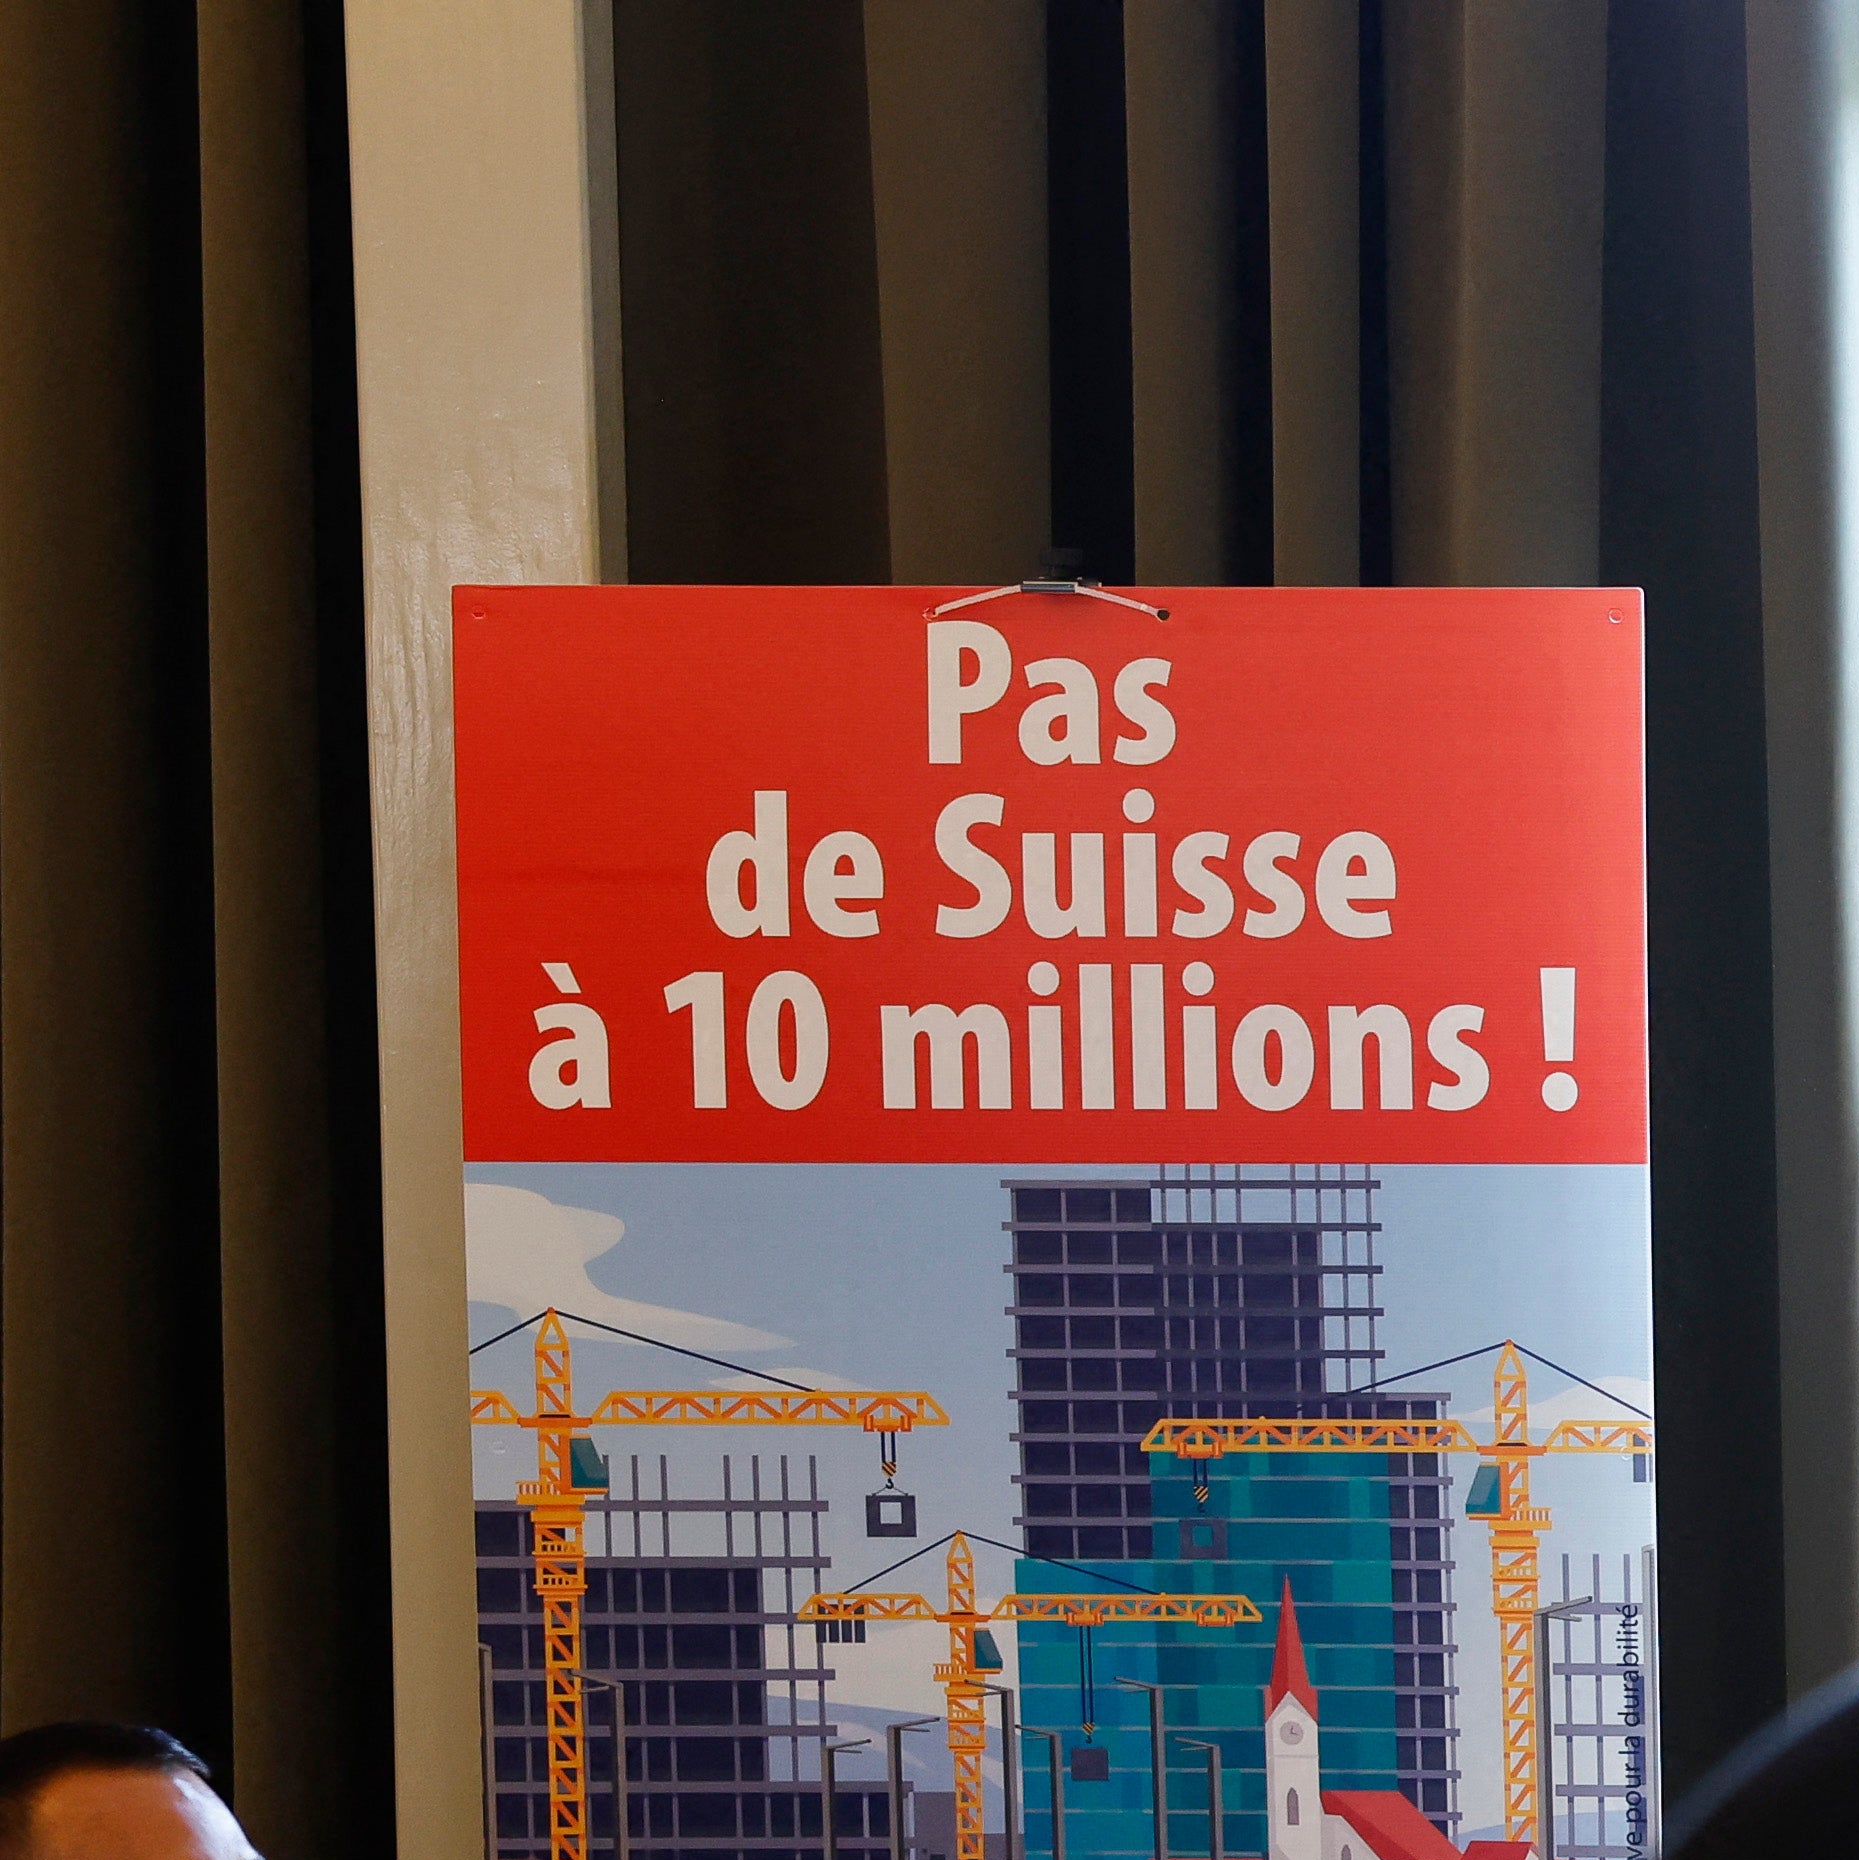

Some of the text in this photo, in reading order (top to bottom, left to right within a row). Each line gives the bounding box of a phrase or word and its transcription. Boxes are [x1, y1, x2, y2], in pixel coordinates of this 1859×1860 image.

[928, 620, 1176, 766] Pas
[706, 788, 1397, 939] de Suisse
[528, 961, 1579, 1112] à 10 millions !
[1615, 1604, 1641, 1727] durabilité
[1618, 1735, 1641, 1755] la
[1626, 1763, 1647, 1825] pour
